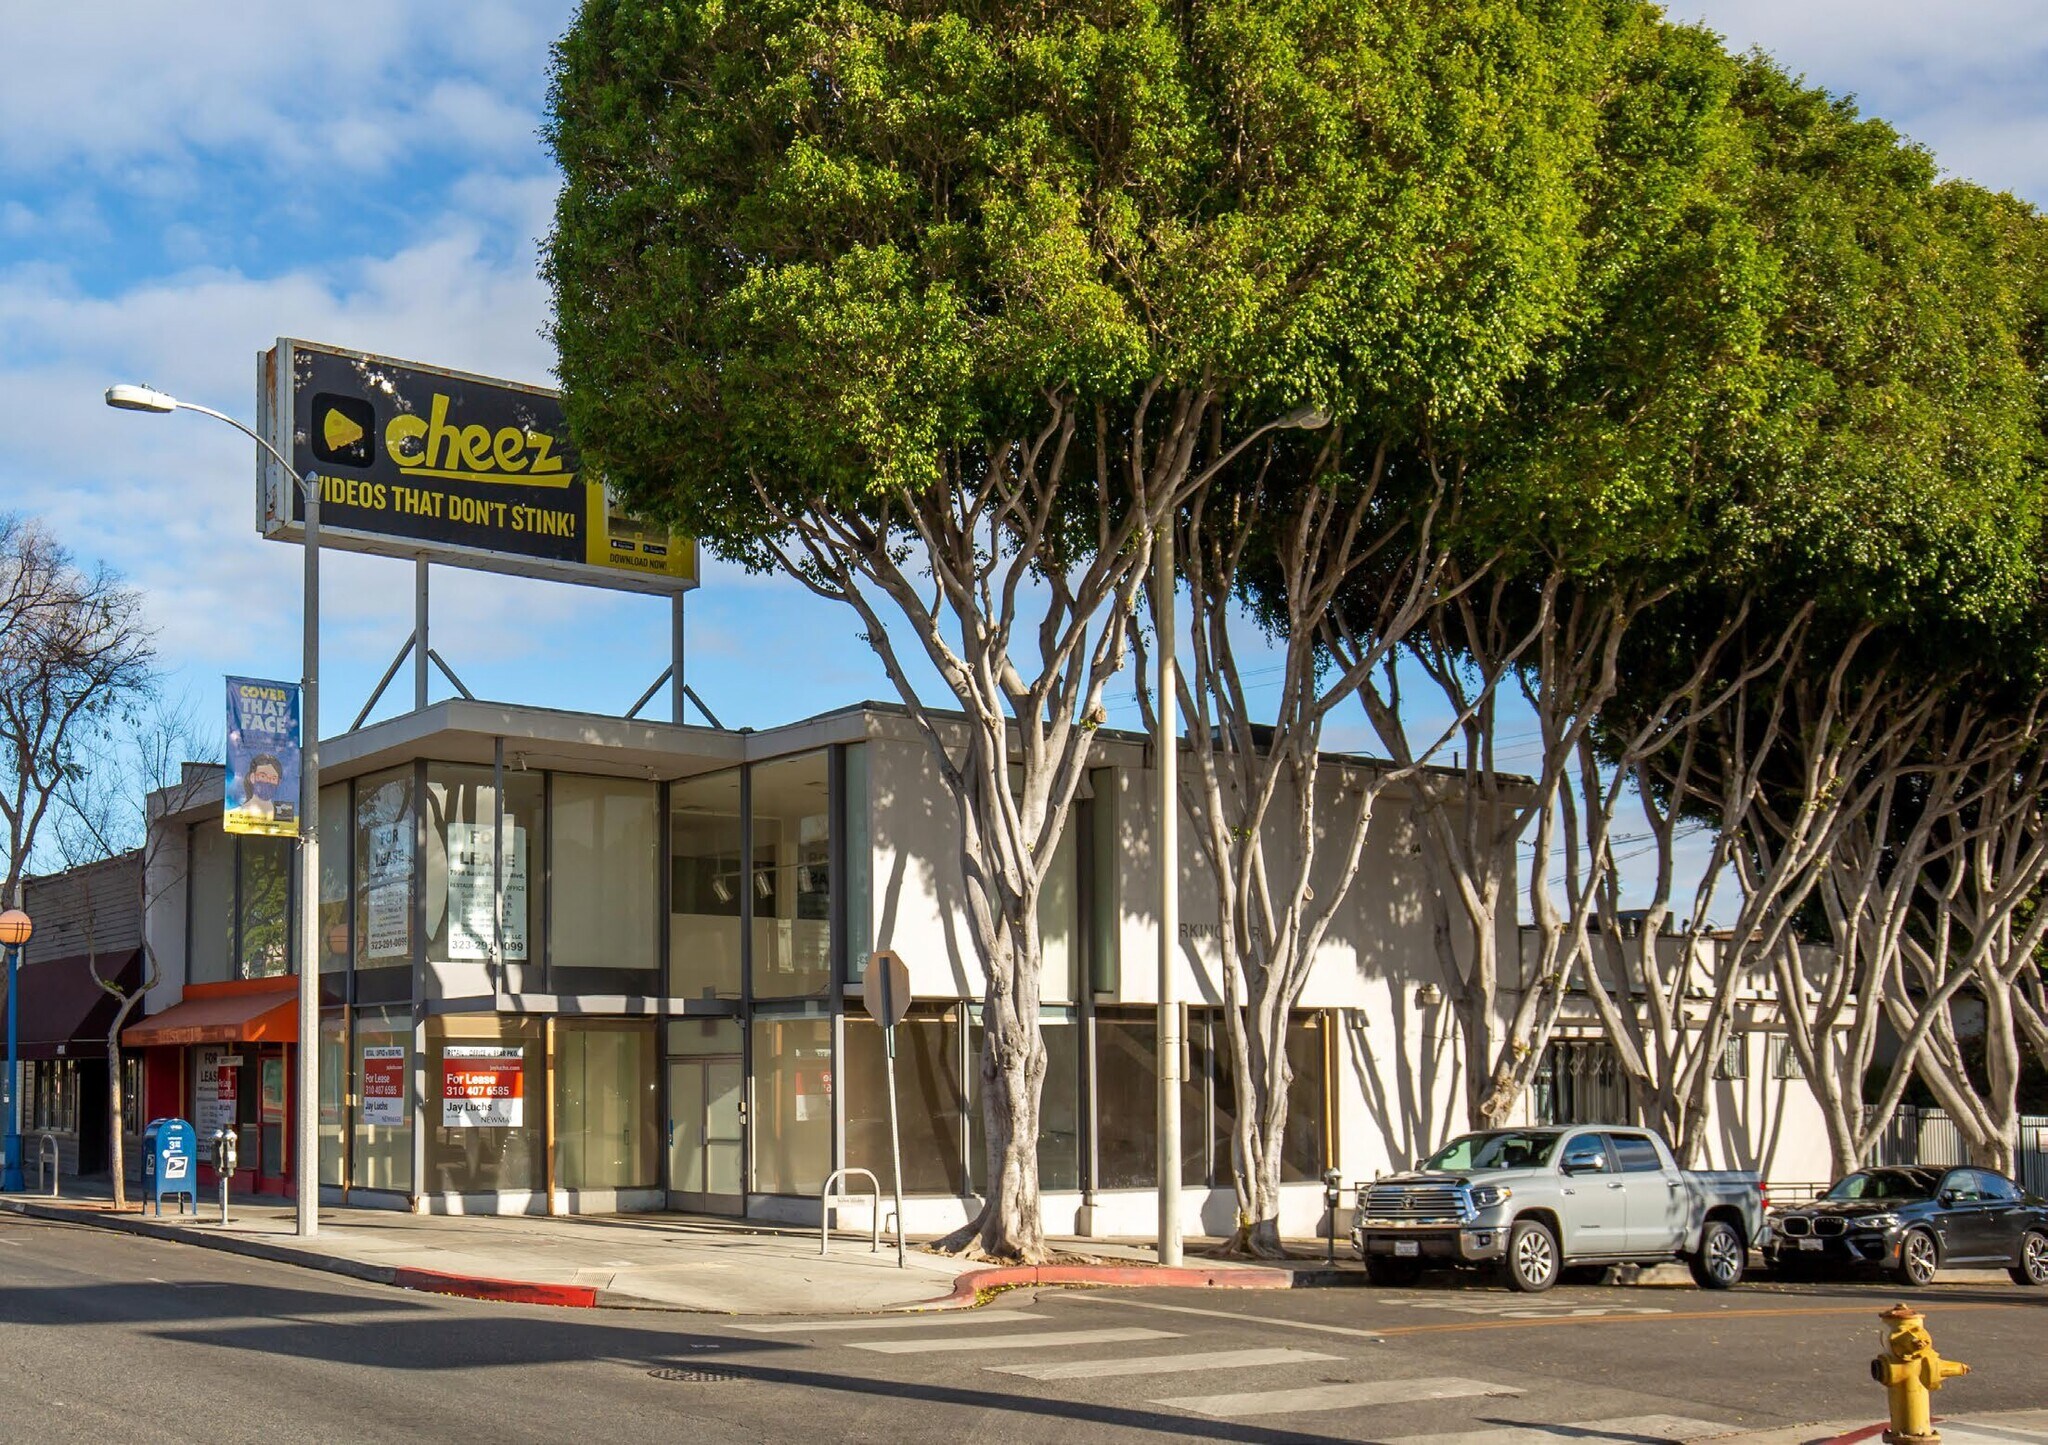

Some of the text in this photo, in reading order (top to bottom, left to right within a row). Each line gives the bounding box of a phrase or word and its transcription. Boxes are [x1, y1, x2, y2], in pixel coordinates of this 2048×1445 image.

[385, 393, 562, 473] cheez
[391, 485, 444, 518] THAT
[449, 495, 507, 528] DON'T
[511, 506, 575, 538] STINK!
[610, 553, 648, 568] DOWNLOAD
[240, 685, 287, 701] COVER
[241, 698, 286, 717] THAT
[241, 714, 287, 734] FACE
[380, 828, 399, 845] FOR
[460, 851, 515, 868] LEAE
[201, 1071, 217, 1082] LEAS
[365, 1073, 390, 1084] For Lease
[446, 1073, 496, 1085] For Lease
[446, 1086, 509, 1096] 310 407 6585
[365, 1101, 388, 1112] Jay Luchs
[446, 1102, 493, 1114] Jay Luchs
